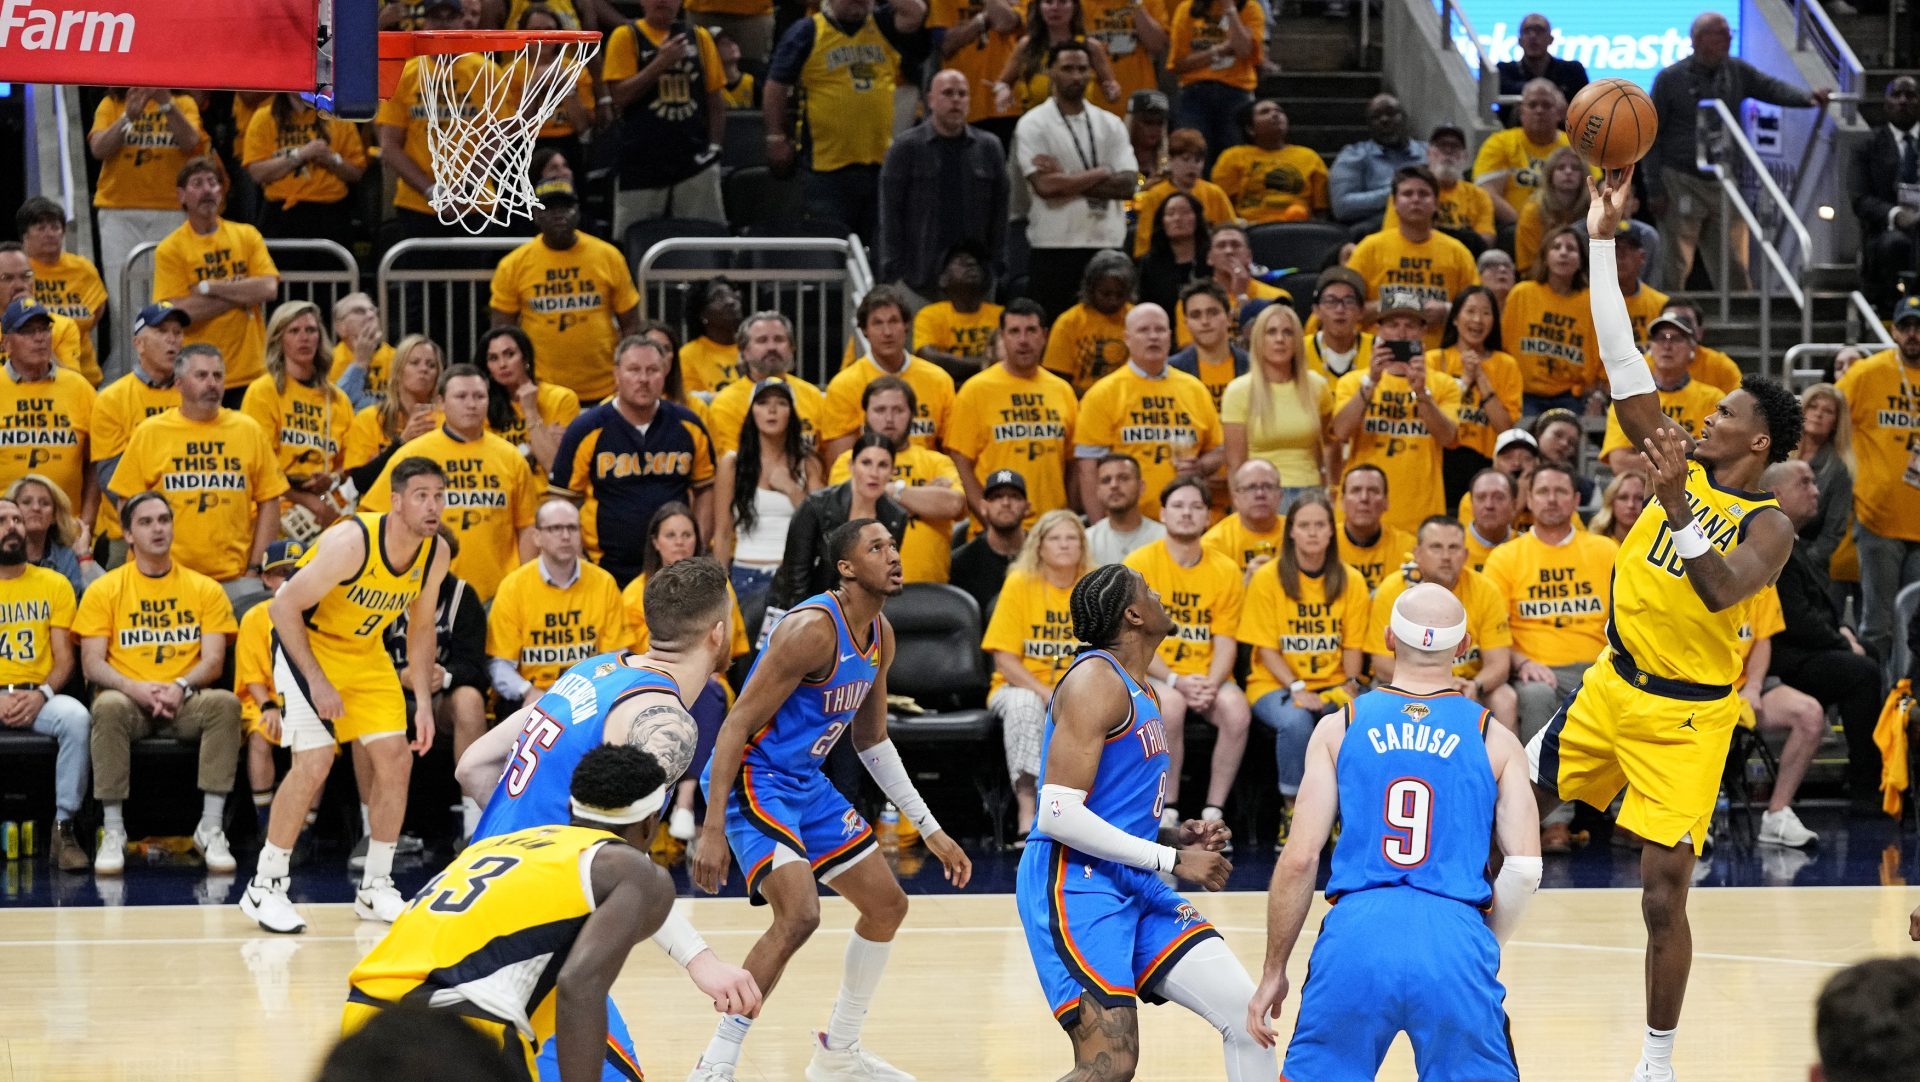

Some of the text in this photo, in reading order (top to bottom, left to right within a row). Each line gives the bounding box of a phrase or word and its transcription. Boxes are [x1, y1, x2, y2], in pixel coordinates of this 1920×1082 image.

[0, 0, 136, 53] Farm
[204, 248, 231, 264] BUT
[1400, 256, 1433, 270] BUT
[546, 266, 580, 280] BUT
[1386, 270, 1445, 286] THIS IS
[35, 279, 67, 292] BUT
[533, 280, 596, 297] THIS IS
[36, 292, 63, 304] HIS
[530, 294, 602, 311] INDIANA
[1543, 311, 1577, 328] BUT
[1529, 323, 1584, 347] THIS IS
[1521, 339, 1584, 363] INDIANA
[17, 397, 55, 412] BUT
[1011, 392, 1044, 407] BUT
[1141, 397, 1175, 409] BUT
[293, 400, 323, 417] BUT
[1000, 408, 1061, 422] THIS IS
[1368, 404, 1406, 419] THIS
[1662, 406, 1685, 418] UT
[3, 413, 71, 428] THIS IS
[285, 413, 319, 432] THIS
[1130, 411, 1191, 425] THIS IS
[0, 430, 79, 445] NDIANA
[995, 424, 1066, 440] INDIANA
[187, 441, 225, 455] BUT
[172, 457, 242, 471] THIS IS
[446, 460, 483, 473] BUT
[164, 474, 246, 490] INDIANA
[446, 475, 501, 488] HIS IS
[446, 492, 507, 506] DIANA
[1540, 567, 1576, 583] BUT
[1528, 581, 1593, 599] THIS IS
[0, 600, 50, 624] DIANA
[141, 597, 178, 613] BUT
[1298, 603, 1331, 618] BUT
[1519, 598, 1601, 616] INDIANA
[129, 609, 196, 629] THIS IS
[545, 609, 582, 628] BUT
[1046, 609, 1071, 624] BU
[1197, 608, 1213, 624] IS
[354, 613, 384, 637] 9
[1031, 625, 1073, 640] THIS
[1288, 619, 1325, 634] THIS
[120, 626, 201, 646] INDIANA
[530, 625, 597, 645] THIS IS
[0, 629, 35, 662] 43
[1281, 638, 1341, 653] INDIAN
[1367, 722, 1461, 759] CARUSO
[1152, 770, 1167, 819] 8
[1382, 776, 1435, 869] 9
